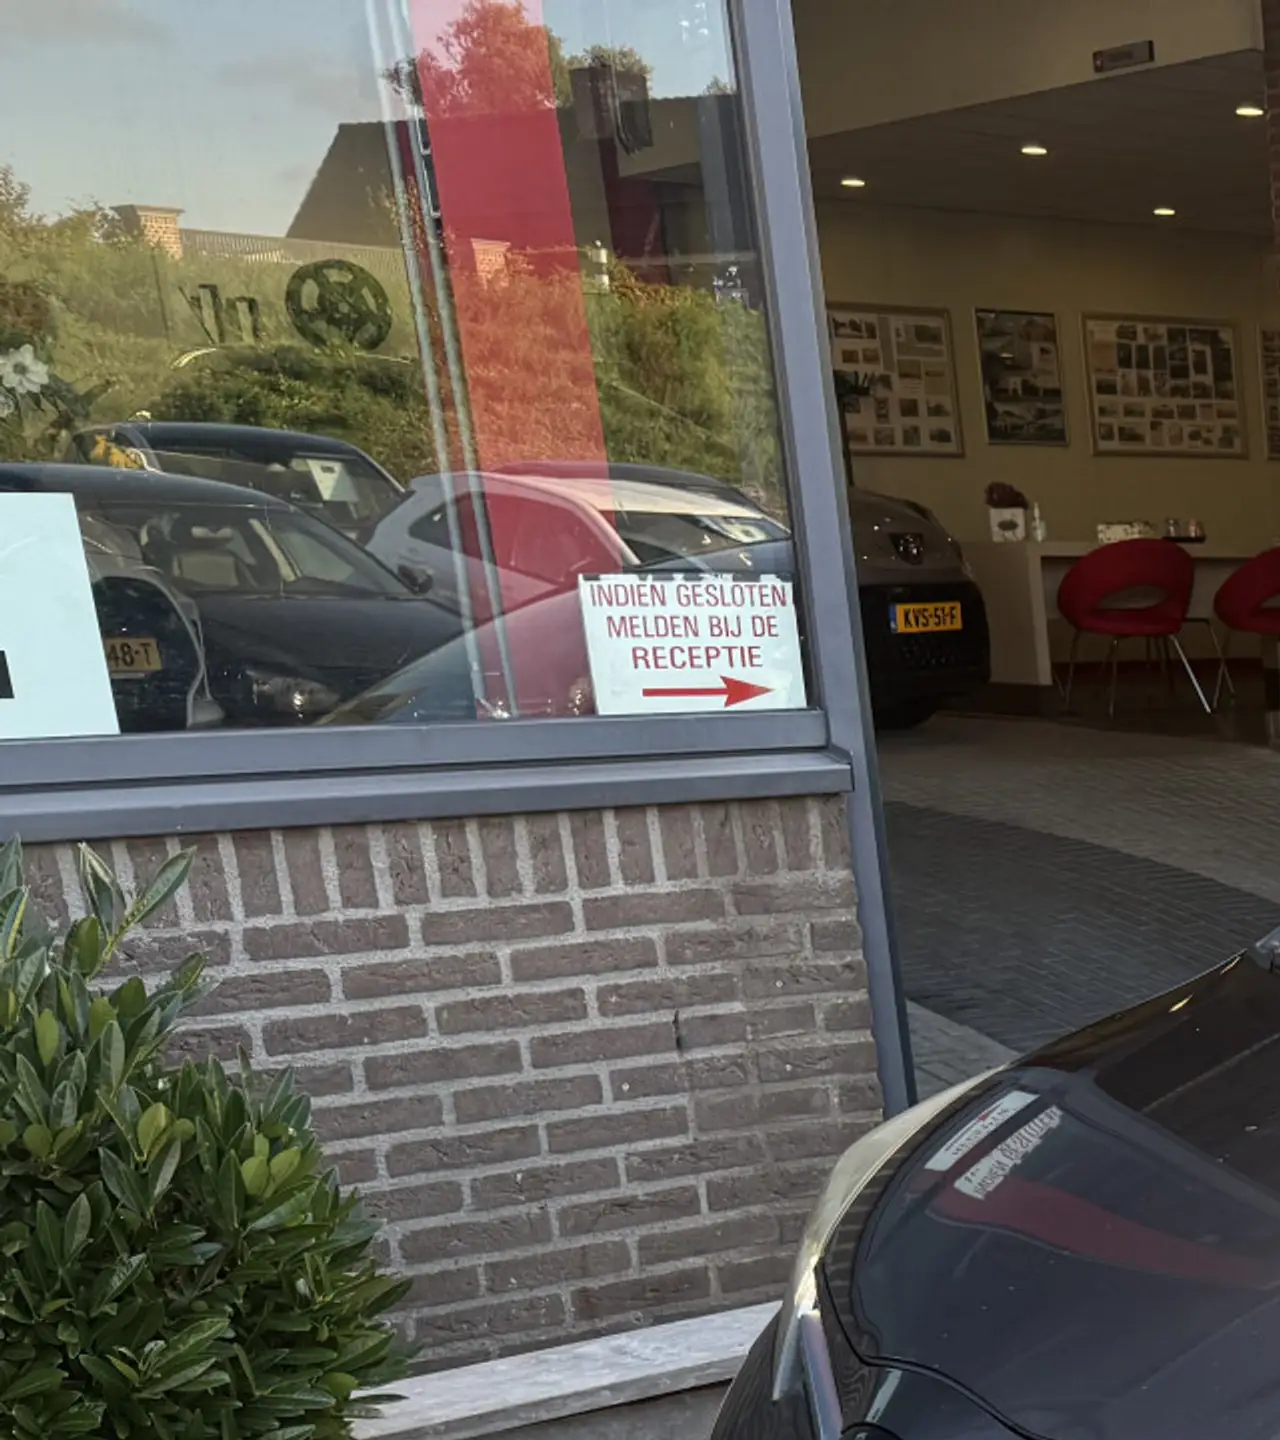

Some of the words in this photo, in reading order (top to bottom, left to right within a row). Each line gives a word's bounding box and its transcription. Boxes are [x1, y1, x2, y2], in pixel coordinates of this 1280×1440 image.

[590, 584, 667, 608] INDIEN
[676, 583, 788, 608] GESLOTEN
[606, 615, 700, 638] MELDEN
[709, 615, 743, 637] BIJ
[751, 615, 780, 637] DE
[631, 645, 764, 669] RECEPTIE
